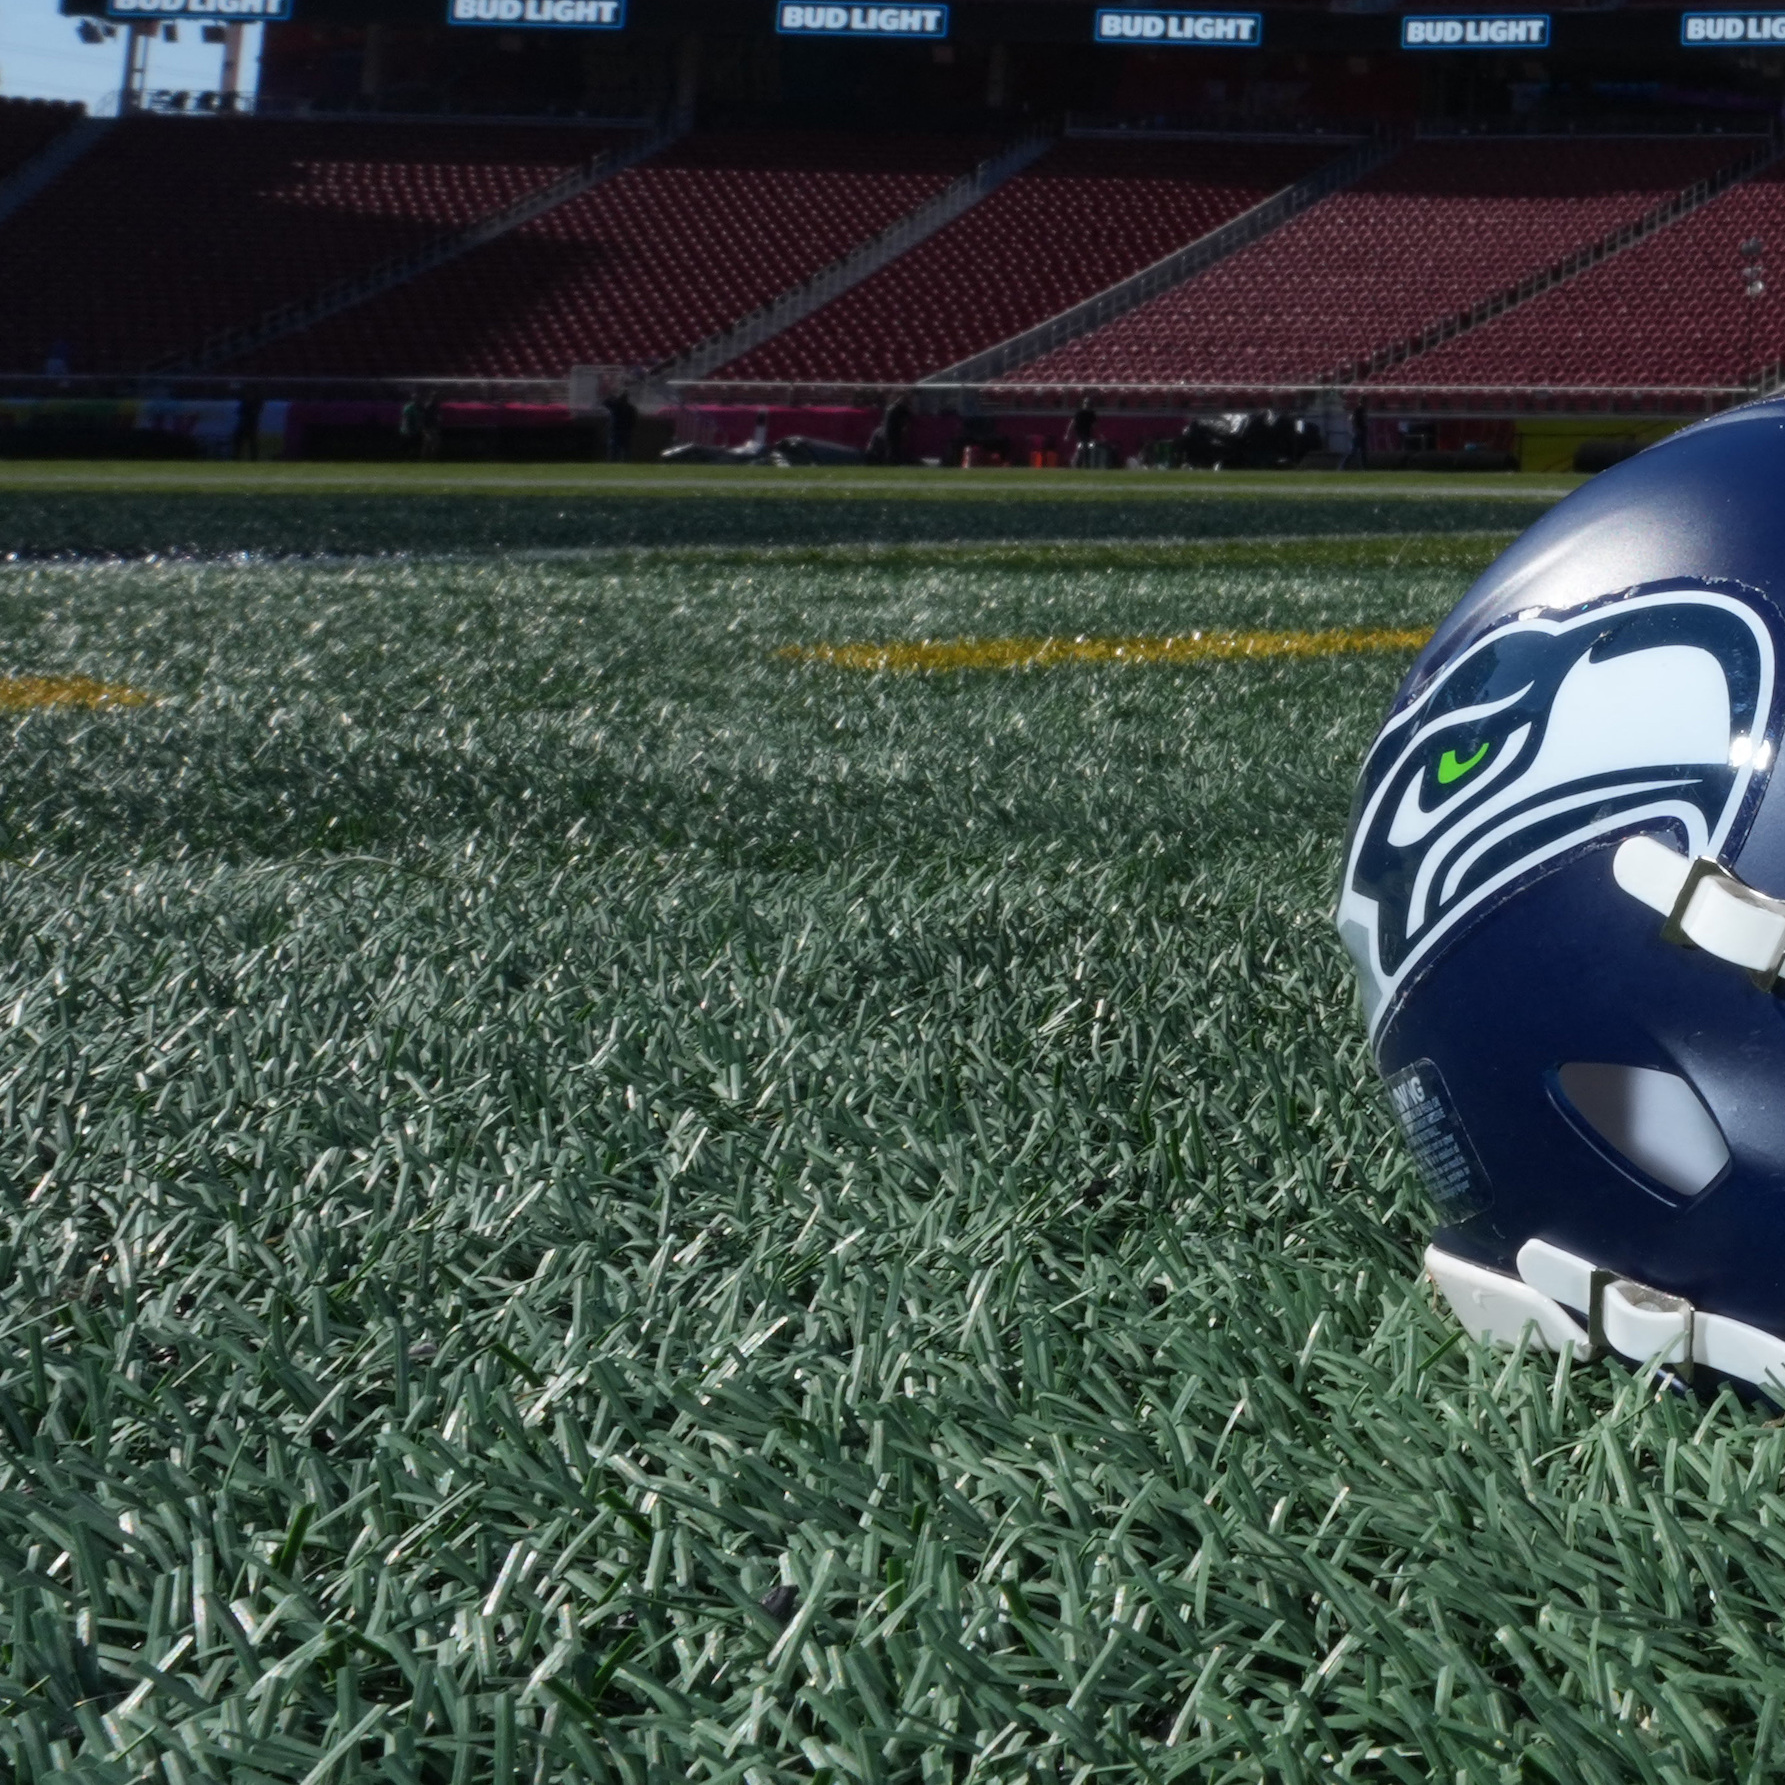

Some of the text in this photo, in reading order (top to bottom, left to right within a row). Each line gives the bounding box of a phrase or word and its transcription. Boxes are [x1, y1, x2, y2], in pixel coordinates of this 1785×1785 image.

[782, 5, 942, 32] BUD LIGHT
[1100, 14, 1256, 41] BUD LIGHT
[1406, 19, 1546, 43] BUD LIGHT
[1686, 17, 1746, 40] BUD
